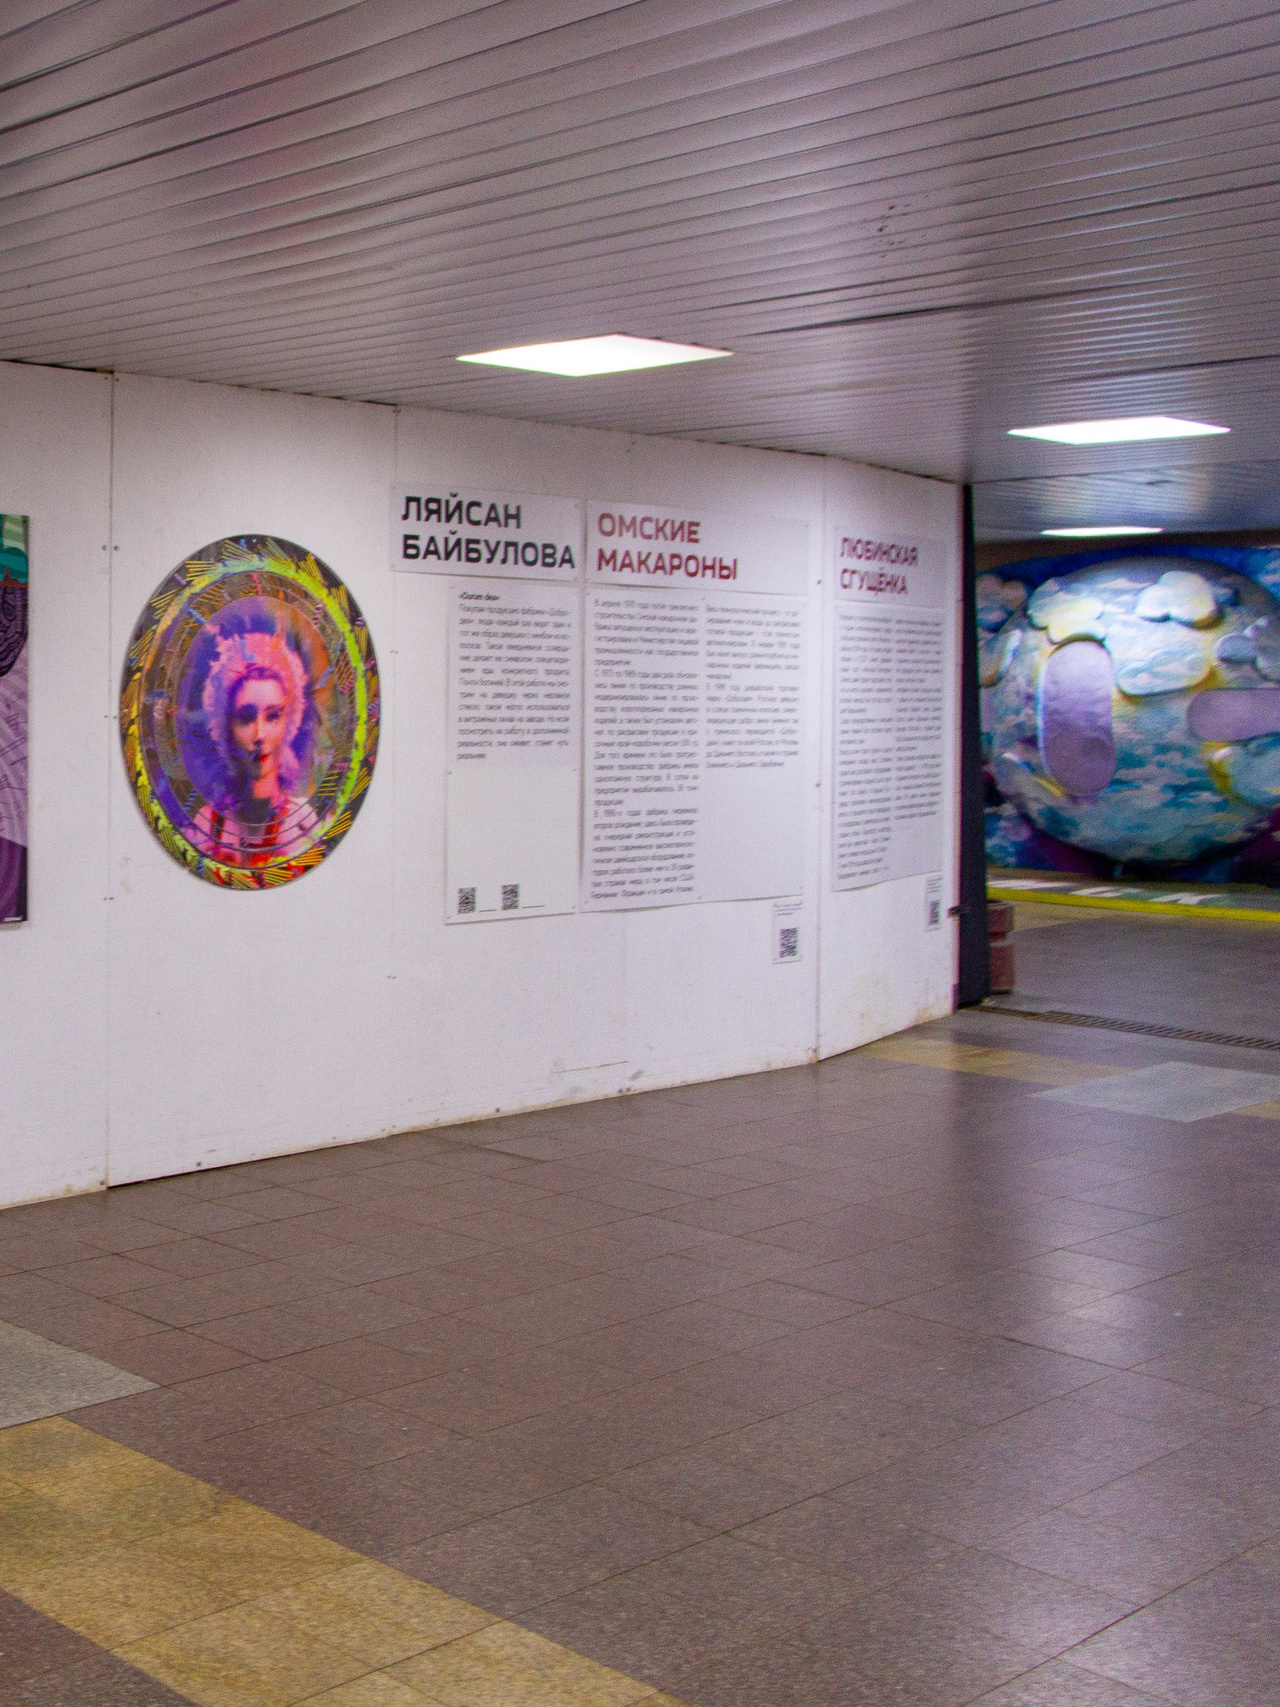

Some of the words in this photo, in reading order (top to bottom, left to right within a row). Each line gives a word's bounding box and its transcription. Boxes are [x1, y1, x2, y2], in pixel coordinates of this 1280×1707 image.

[401, 493, 522, 529] ЛЯЙСАН
[597, 512, 700, 543] ОМСКИЕ
[402, 531, 576, 569] БАЙБУЛОВА
[597, 548, 738, 580] МАКАРОНЫ
[840, 537, 918, 566] ЛЮБИНСКАЯ
